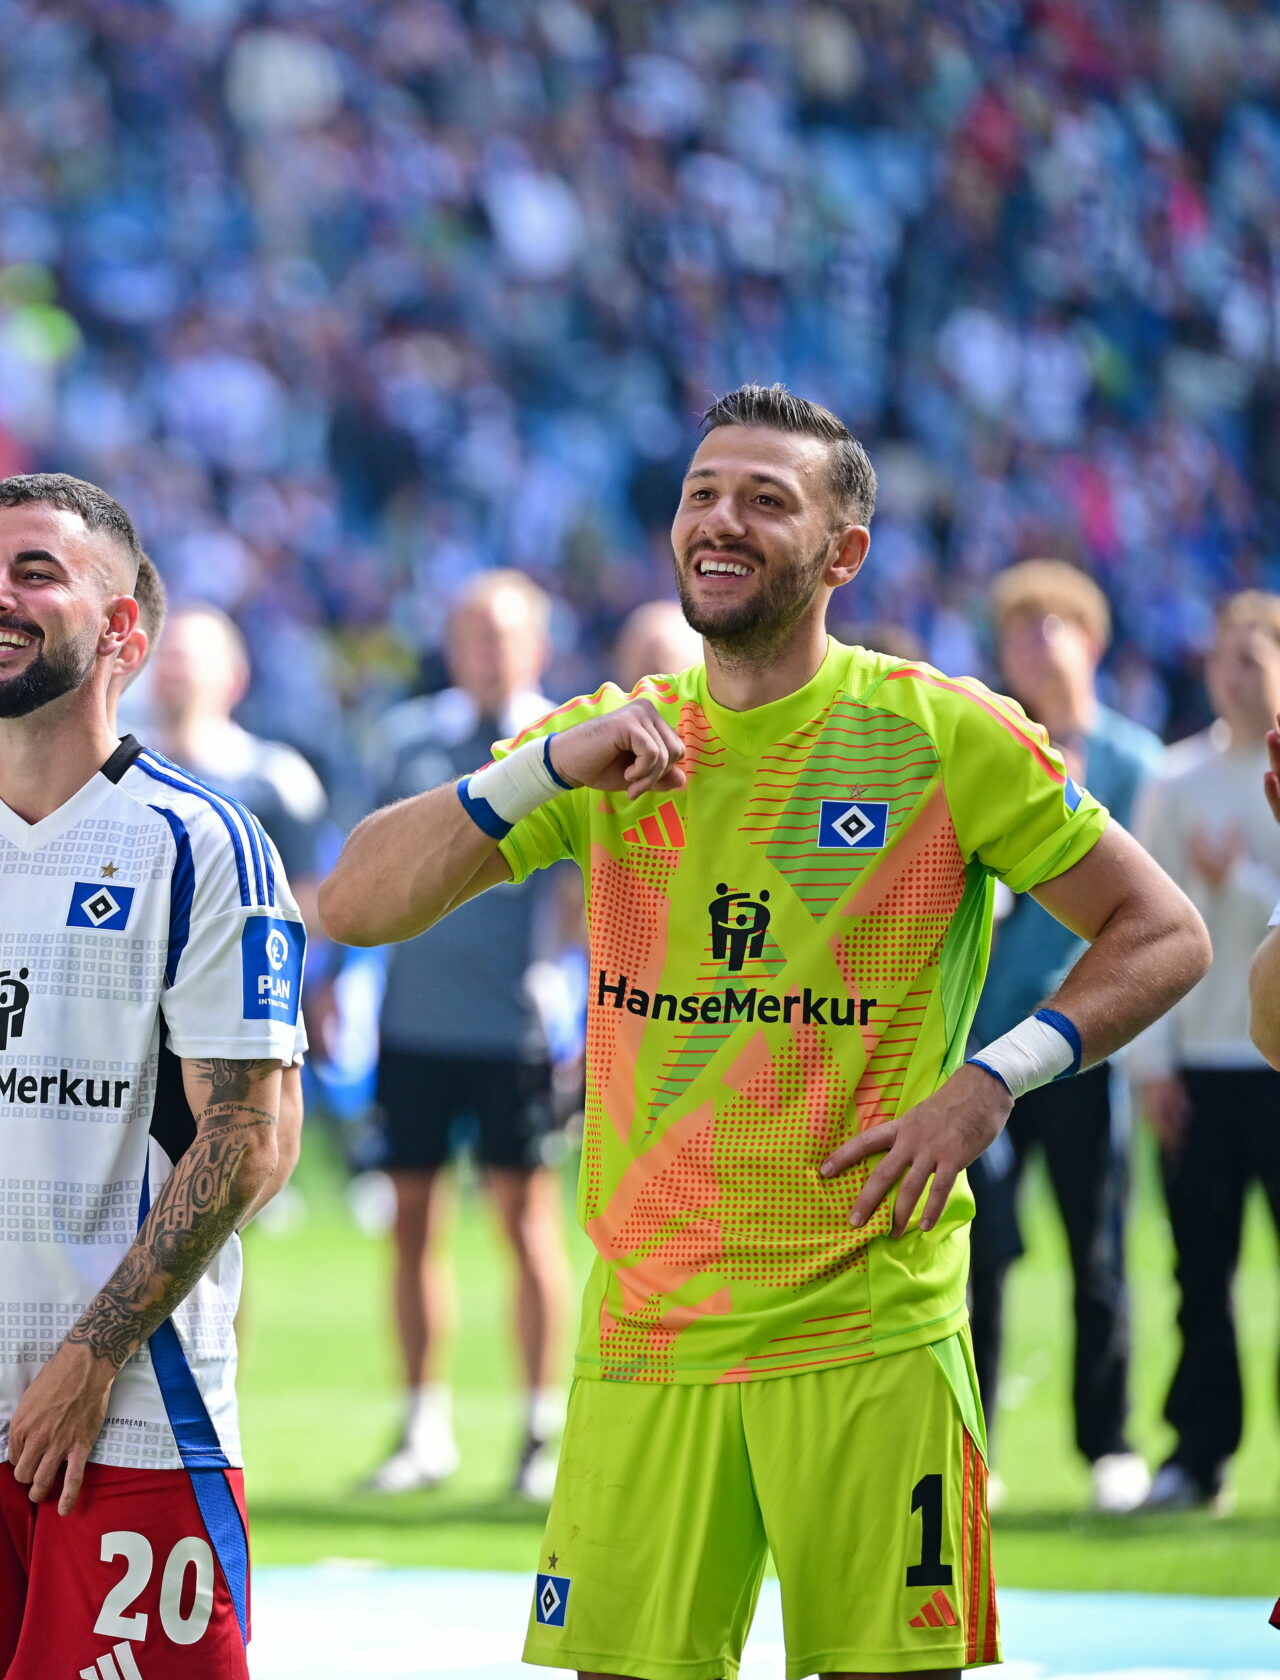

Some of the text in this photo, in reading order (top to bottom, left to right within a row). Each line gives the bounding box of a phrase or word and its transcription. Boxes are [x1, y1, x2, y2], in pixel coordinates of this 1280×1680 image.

[258, 974, 291, 1000] PLAN
[598, 970, 877, 1026] HanseMerkur
[906, 1473, 953, 1587] 1
[93, 1530, 214, 1645] 20
